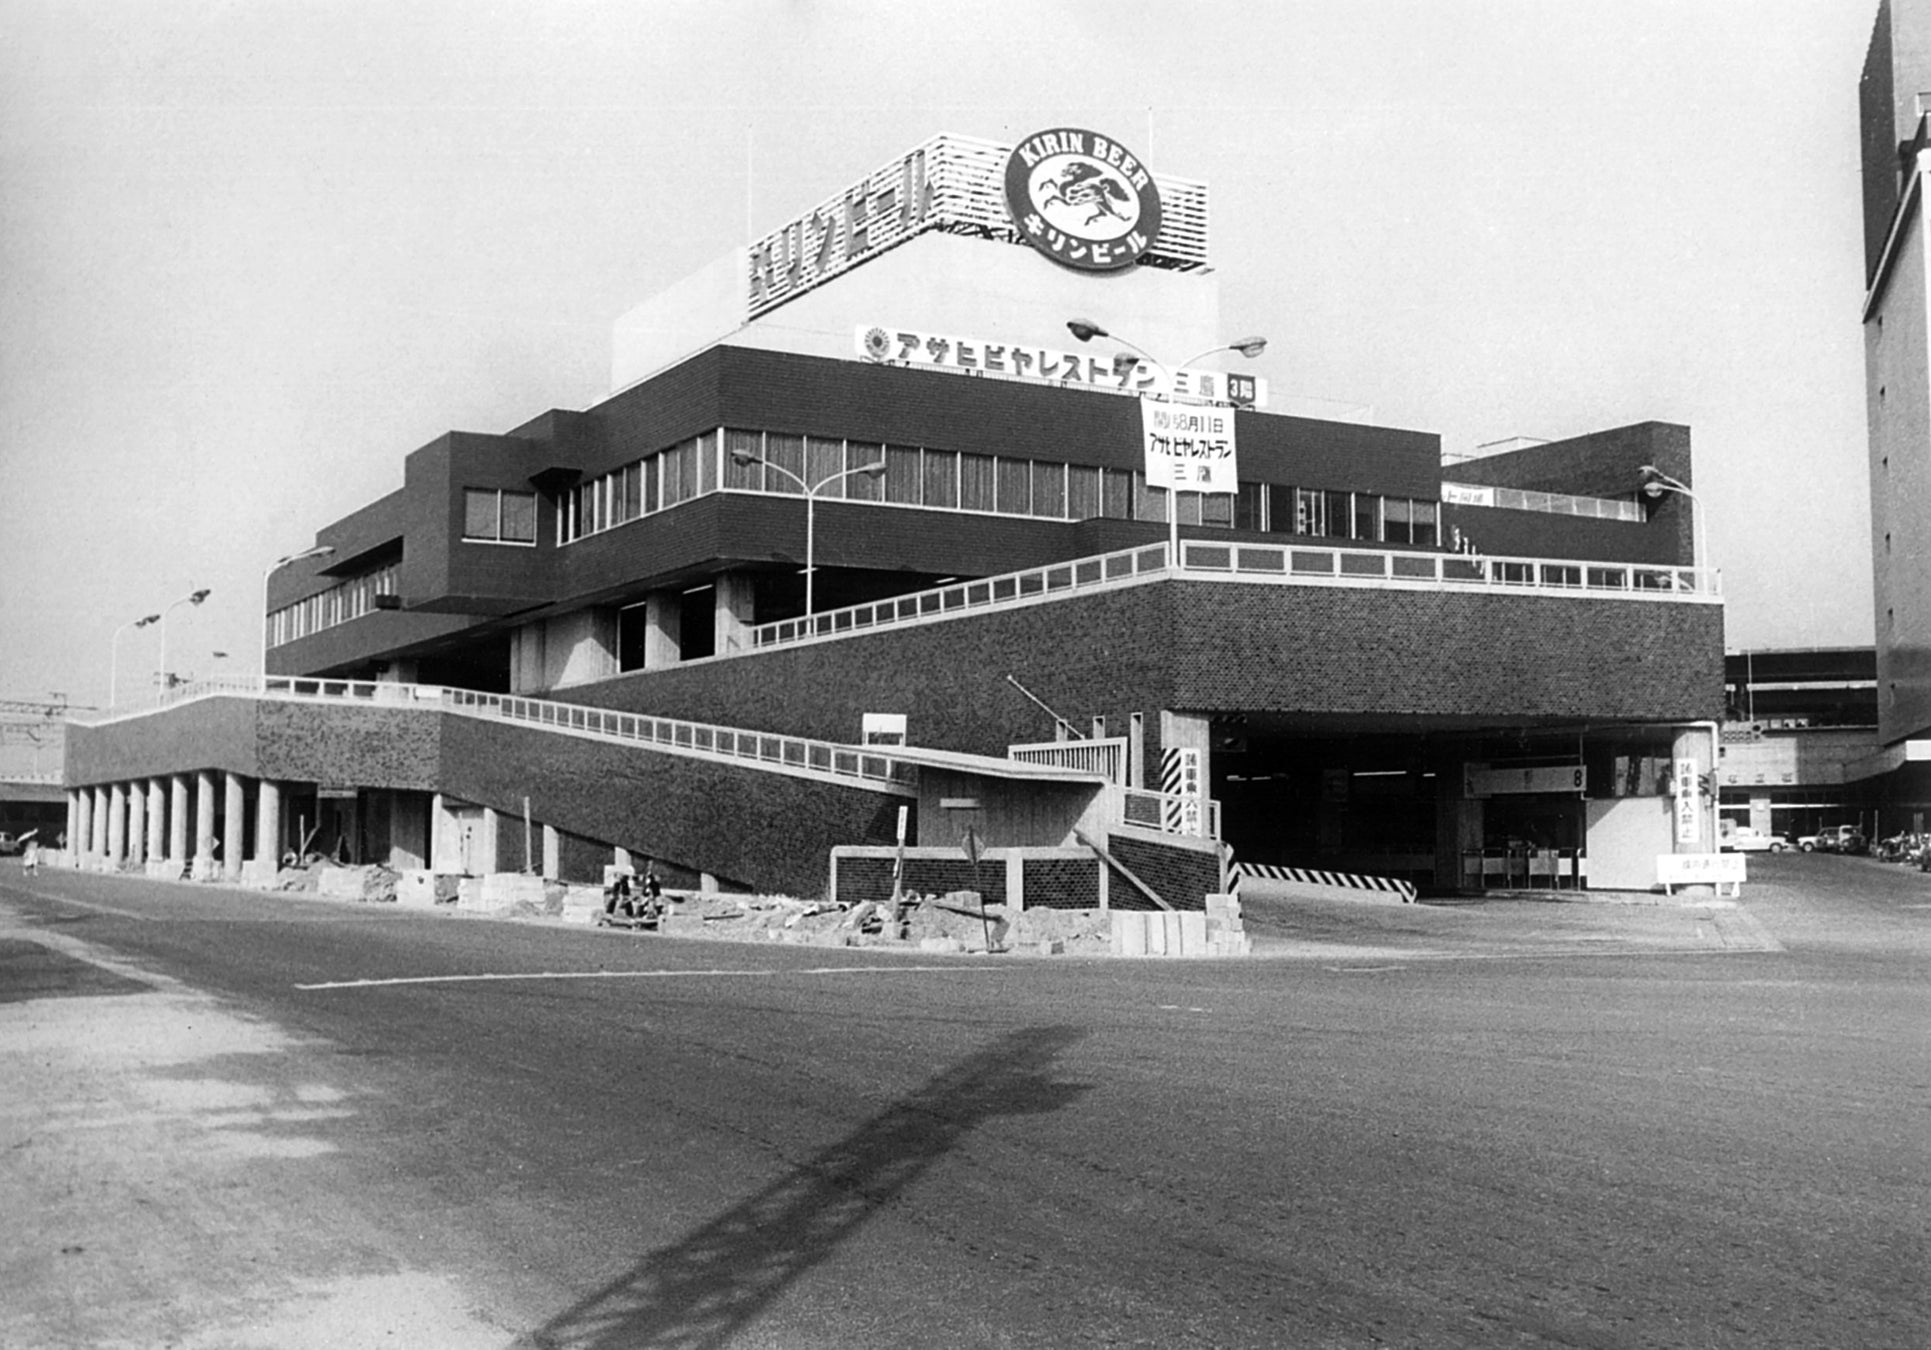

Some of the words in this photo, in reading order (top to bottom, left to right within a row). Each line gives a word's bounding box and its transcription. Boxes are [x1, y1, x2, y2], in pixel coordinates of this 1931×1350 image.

[1018, 131, 1084, 168] KIRIN
[1092, 136, 1150, 191] BEER
[1023, 212, 1148, 263] キリンビール
[1573, 769, 1583, 788] 8
